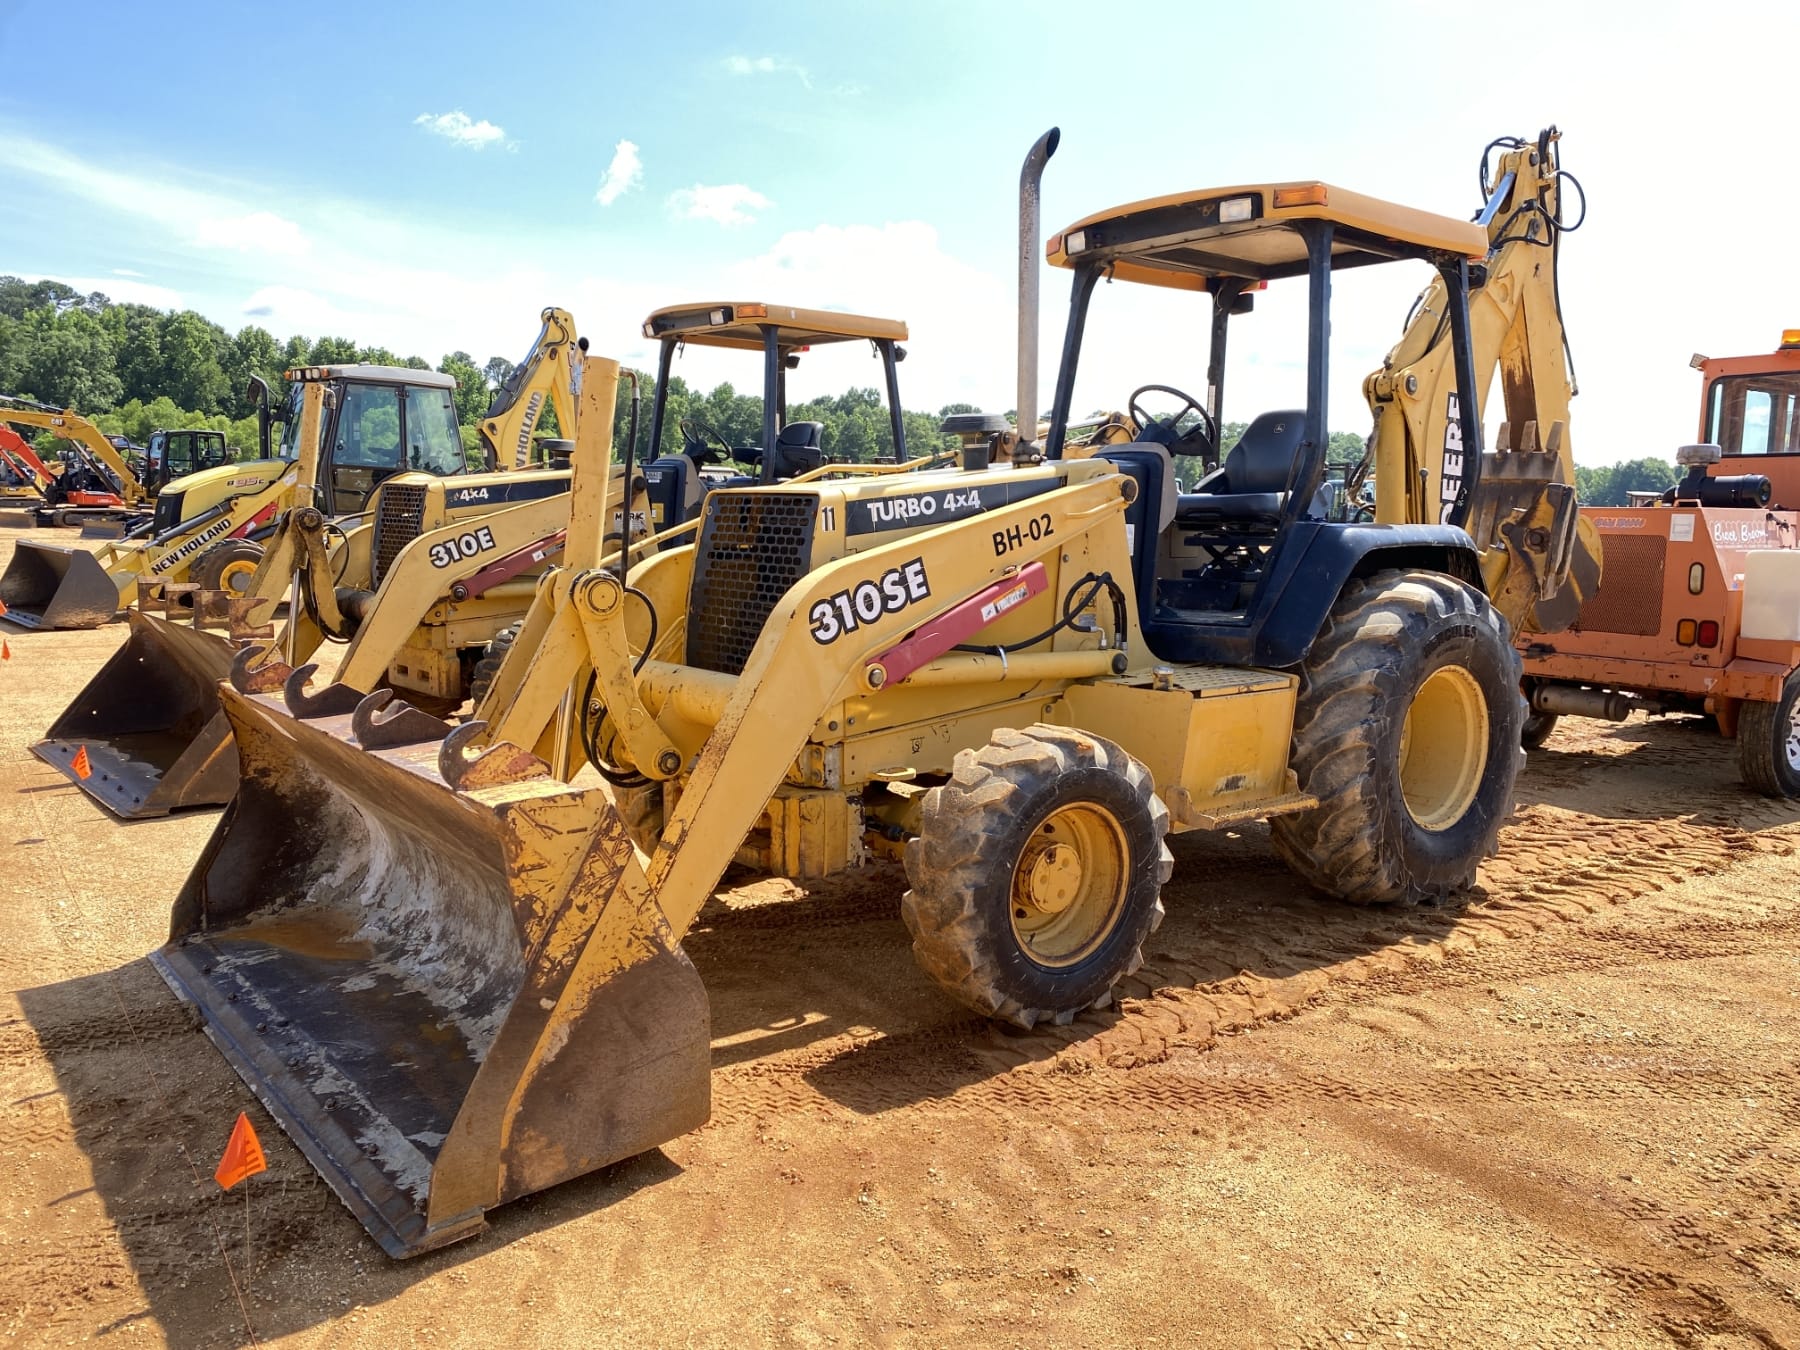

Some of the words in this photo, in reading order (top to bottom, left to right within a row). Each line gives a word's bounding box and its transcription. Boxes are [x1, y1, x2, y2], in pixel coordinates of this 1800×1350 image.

[516, 391, 542, 457] HOLLAND
[460, 487, 489, 501] 4x4
[867, 496, 937, 522] TURBO
[943, 490, 981, 512] 4x4
[821, 506, 836, 532] 11
[992, 513, 1054, 557] BH-02
[151, 554, 181, 575] NEW
[178, 518, 232, 557] HOLLAND
[429, 526, 496, 569] 310E
[809, 556, 931, 645] 310SE
